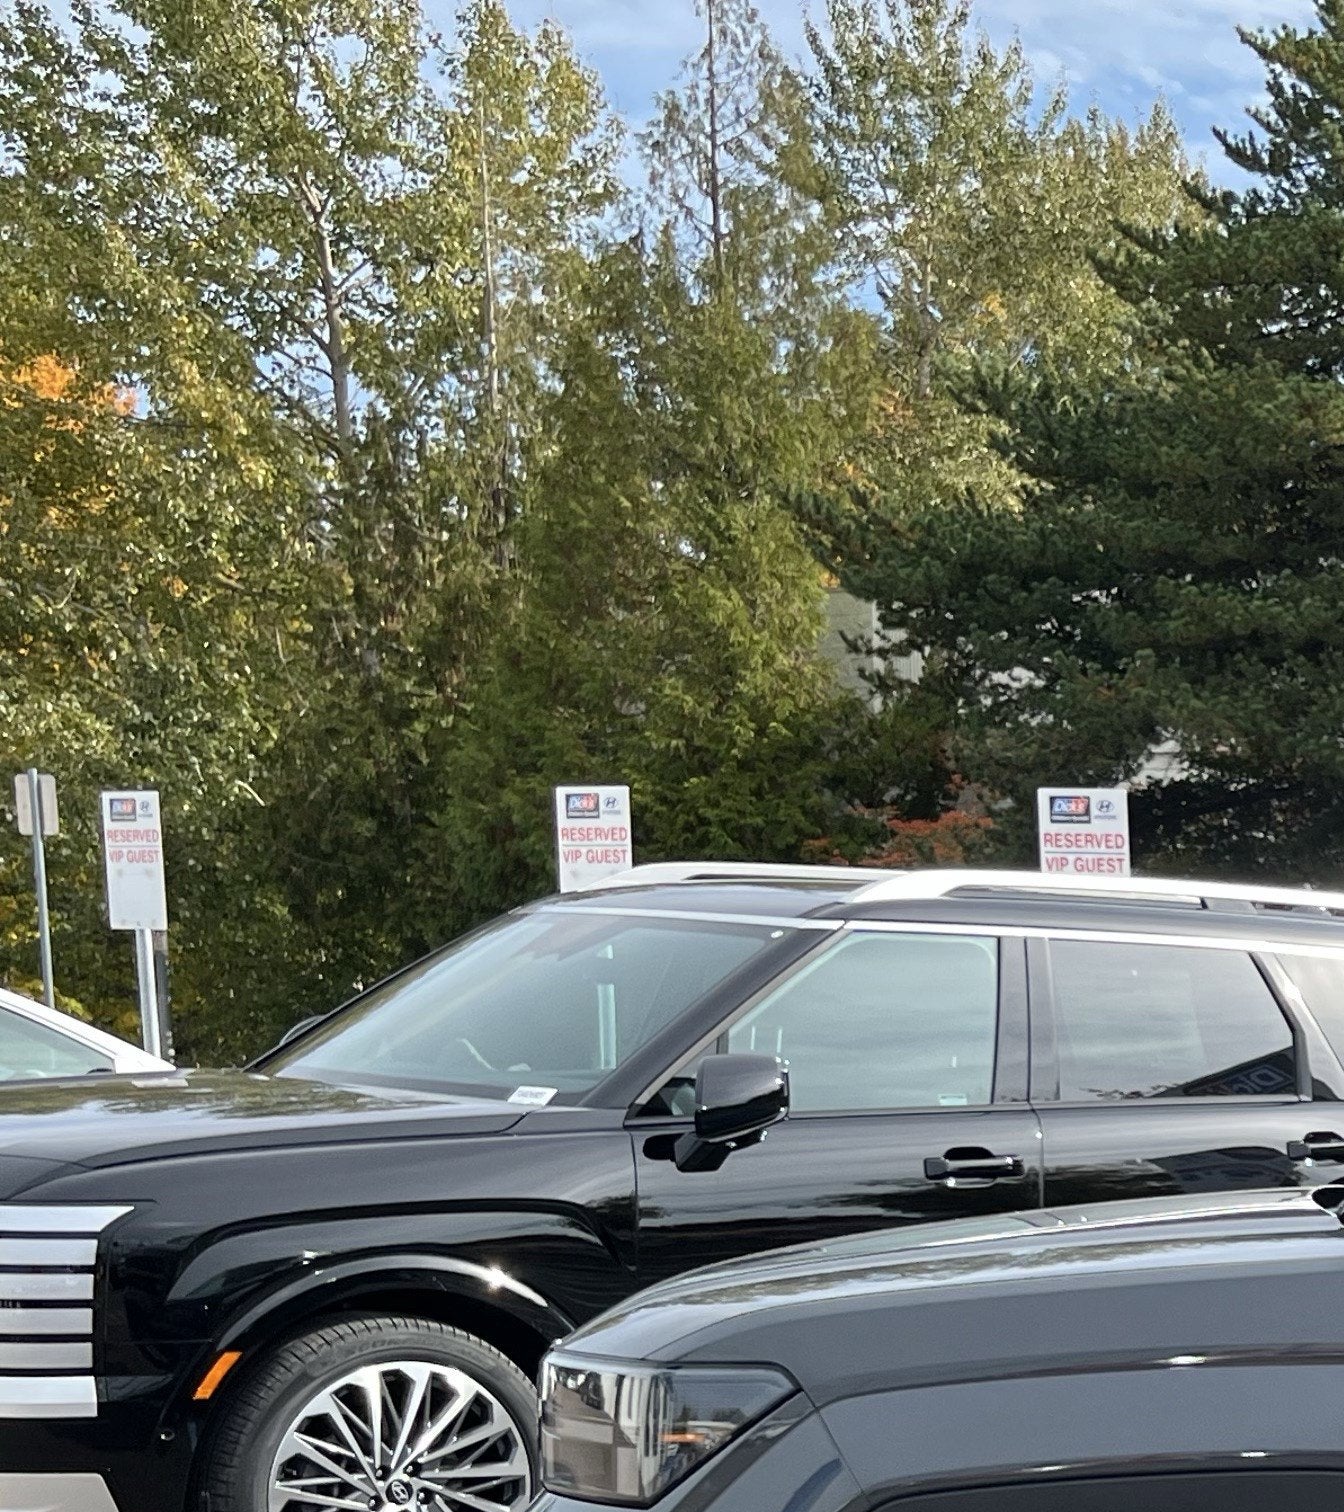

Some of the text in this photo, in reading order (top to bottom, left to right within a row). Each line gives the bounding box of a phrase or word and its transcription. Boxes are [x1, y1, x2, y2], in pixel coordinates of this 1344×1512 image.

[106, 828, 160, 843] RESERVED
[561, 827, 628, 842] RESERVED
[1043, 832, 1126, 850] RESERVED
[108, 849, 160, 864] VIP GUEST
[562, 849, 628, 864] VIP GUEST
[1045, 856, 1126, 874] VIP GUEST
